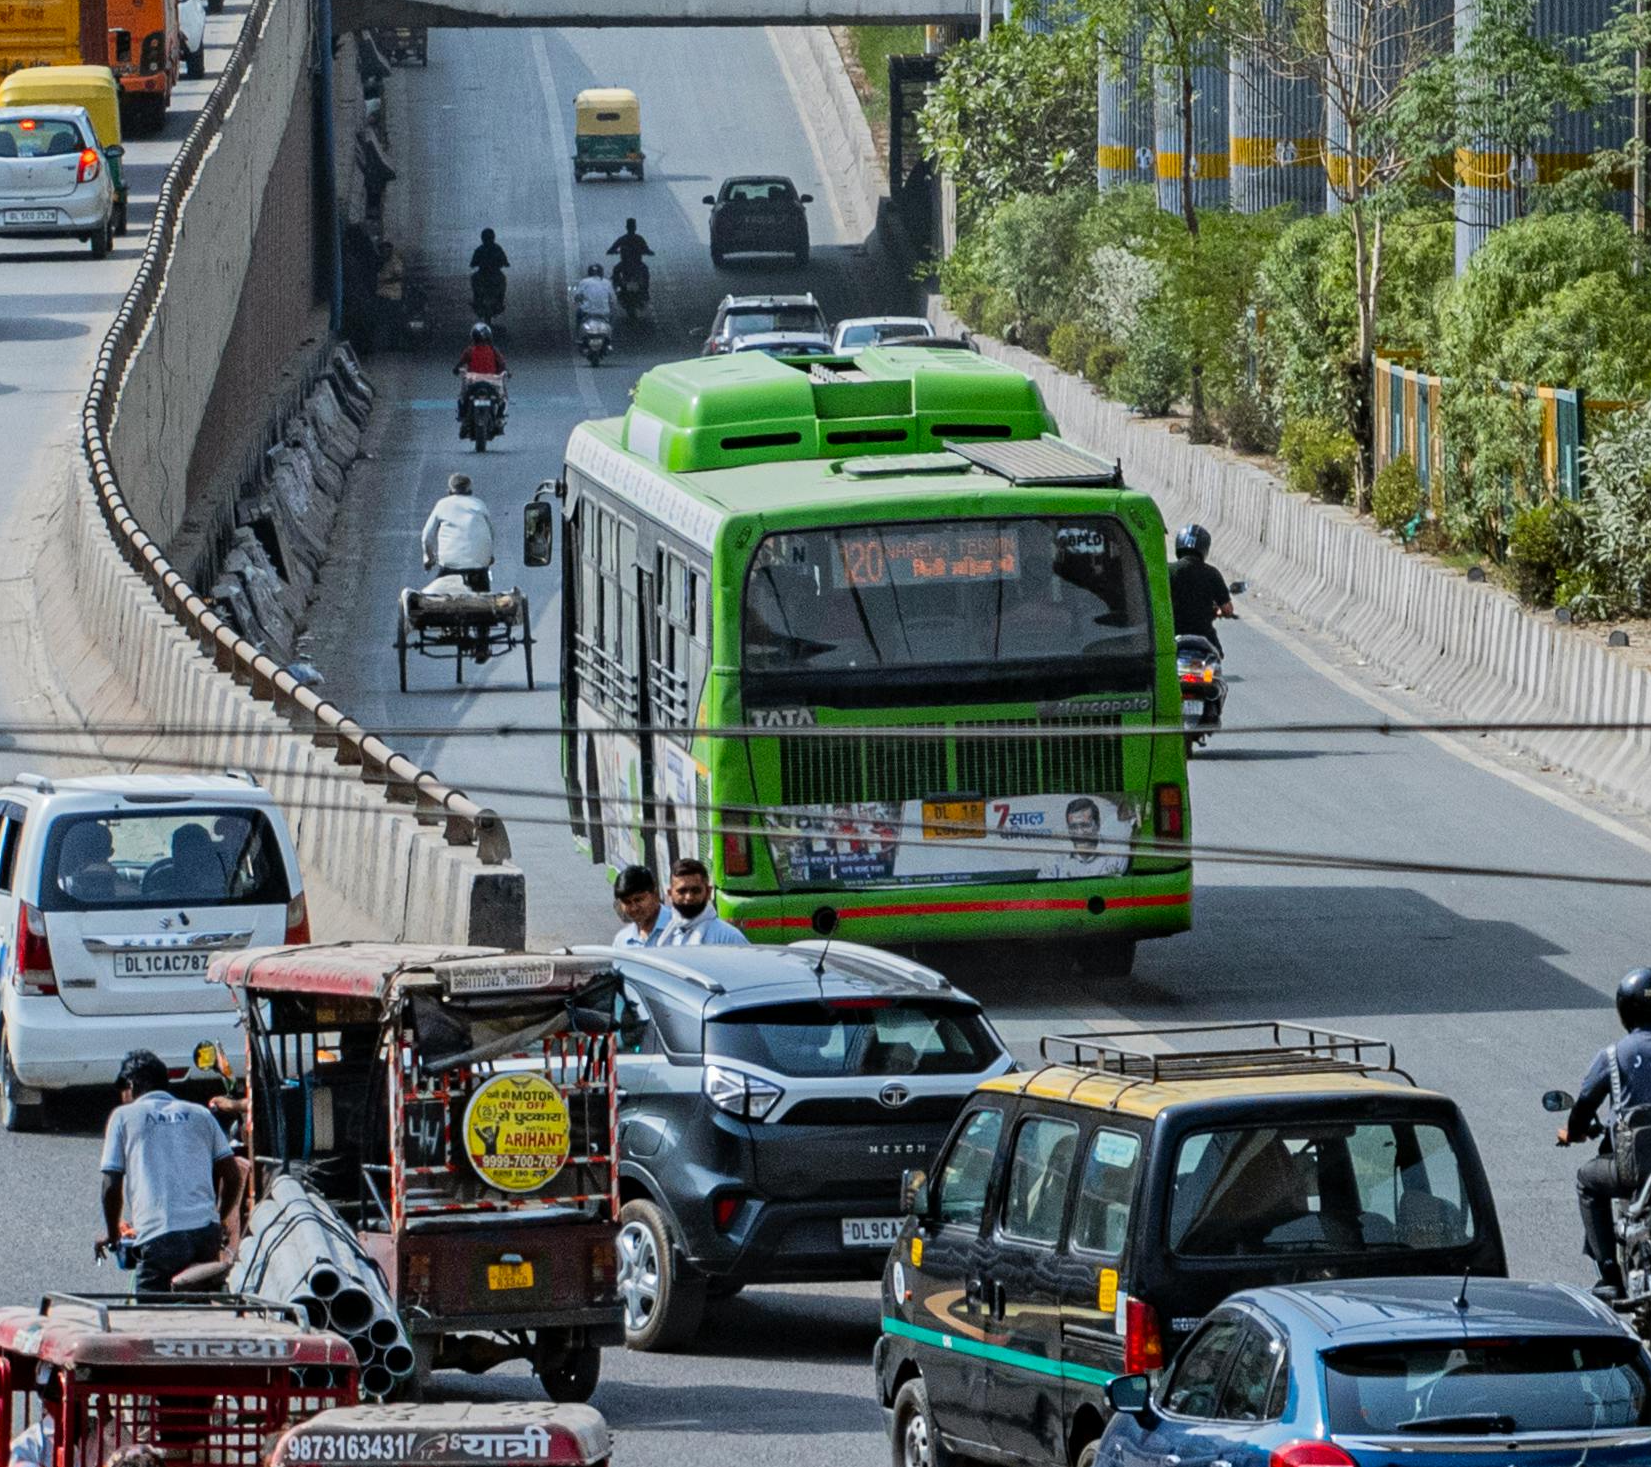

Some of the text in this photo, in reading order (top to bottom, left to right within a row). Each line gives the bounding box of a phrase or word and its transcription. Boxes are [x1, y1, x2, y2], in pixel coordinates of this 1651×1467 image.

[792, 546, 806, 563] N
[751, 709, 815, 728] TATA
[993, 804, 1045, 829] 7 साल
[512, 1090, 555, 1102] MOTOR
[498, 1102, 516, 1110] ON
[526, 1102, 548, 1110] OFF
[504, 1132, 565, 1148] ARIHANT
[868, 1143, 926, 1154] NEXON
[481, 1155, 559, 1169] 9999-700-705
[461, 1427, 553, 1459] यात्री
